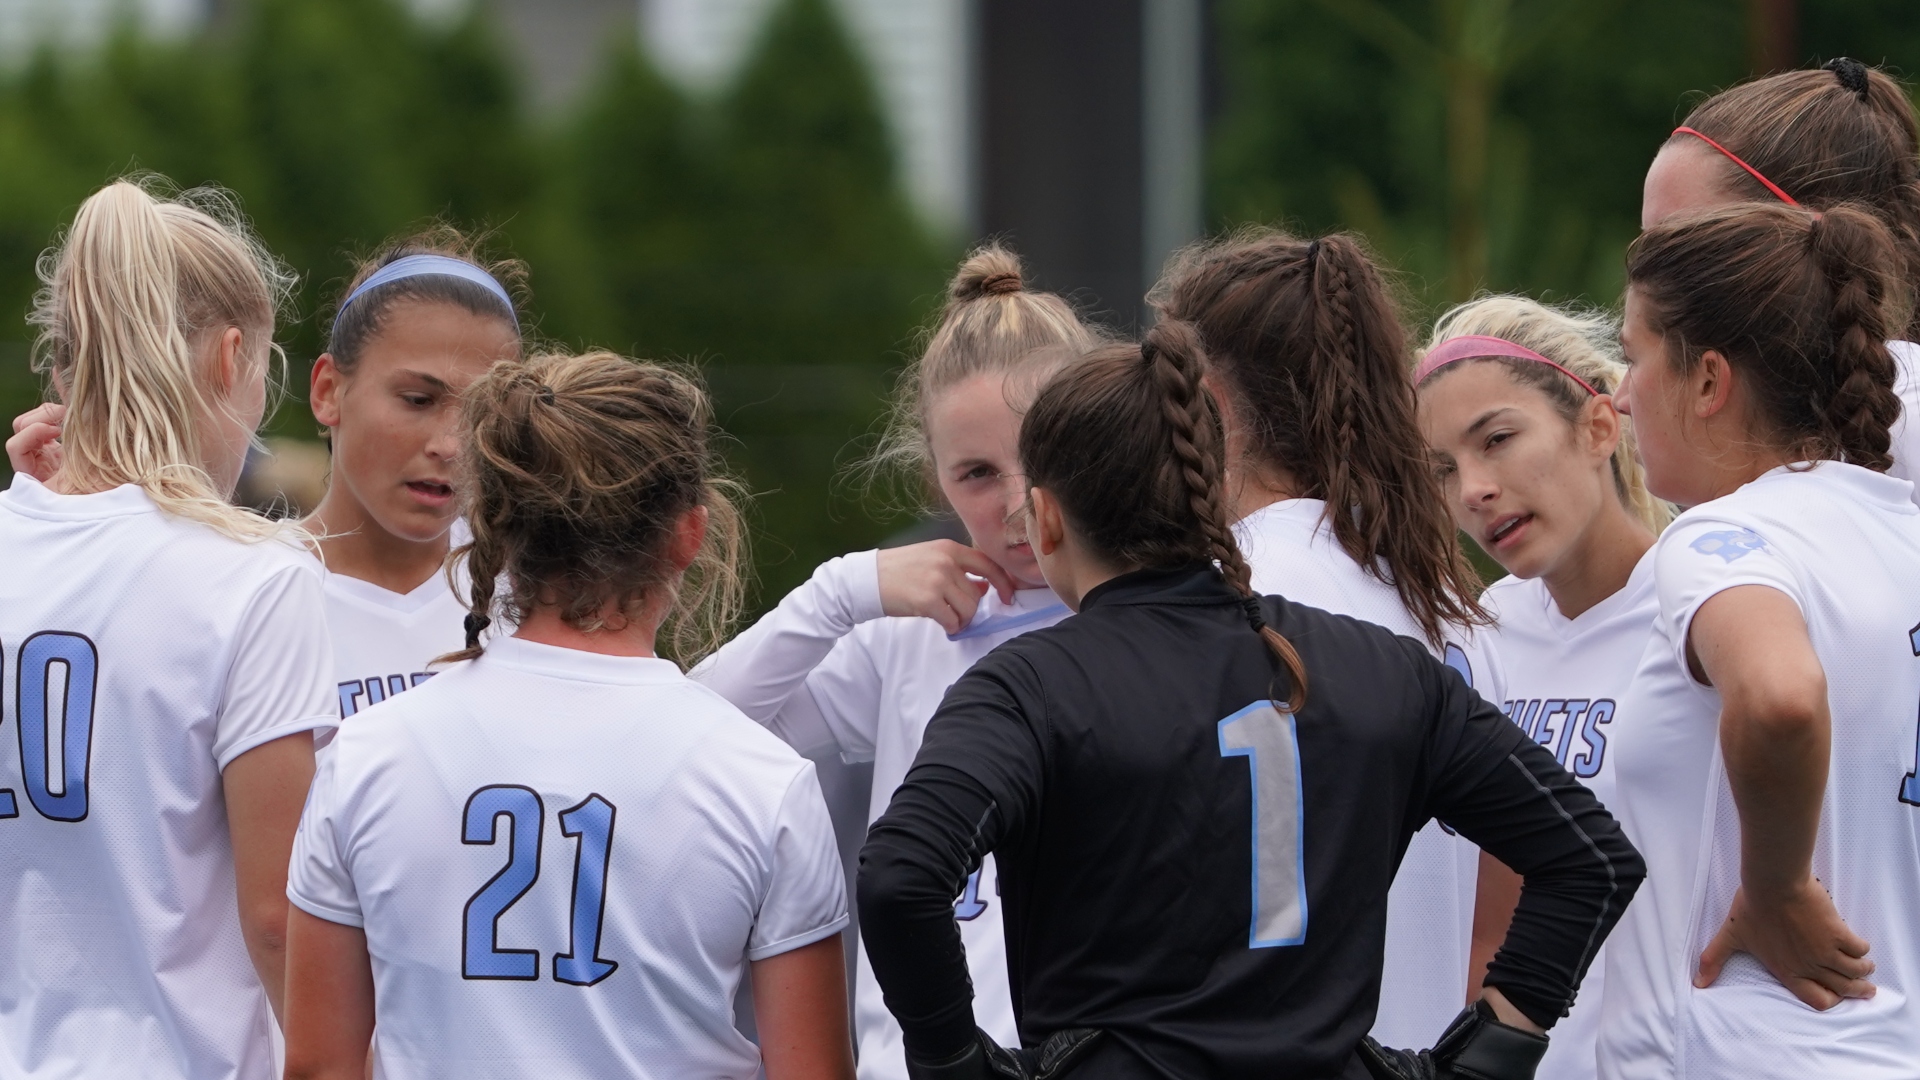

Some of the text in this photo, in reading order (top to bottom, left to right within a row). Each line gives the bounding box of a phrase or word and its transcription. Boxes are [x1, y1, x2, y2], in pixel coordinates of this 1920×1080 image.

[0, 630, 98, 822] 0
[1217, 700, 1308, 948] 1
[461, 784, 618, 987] 21
